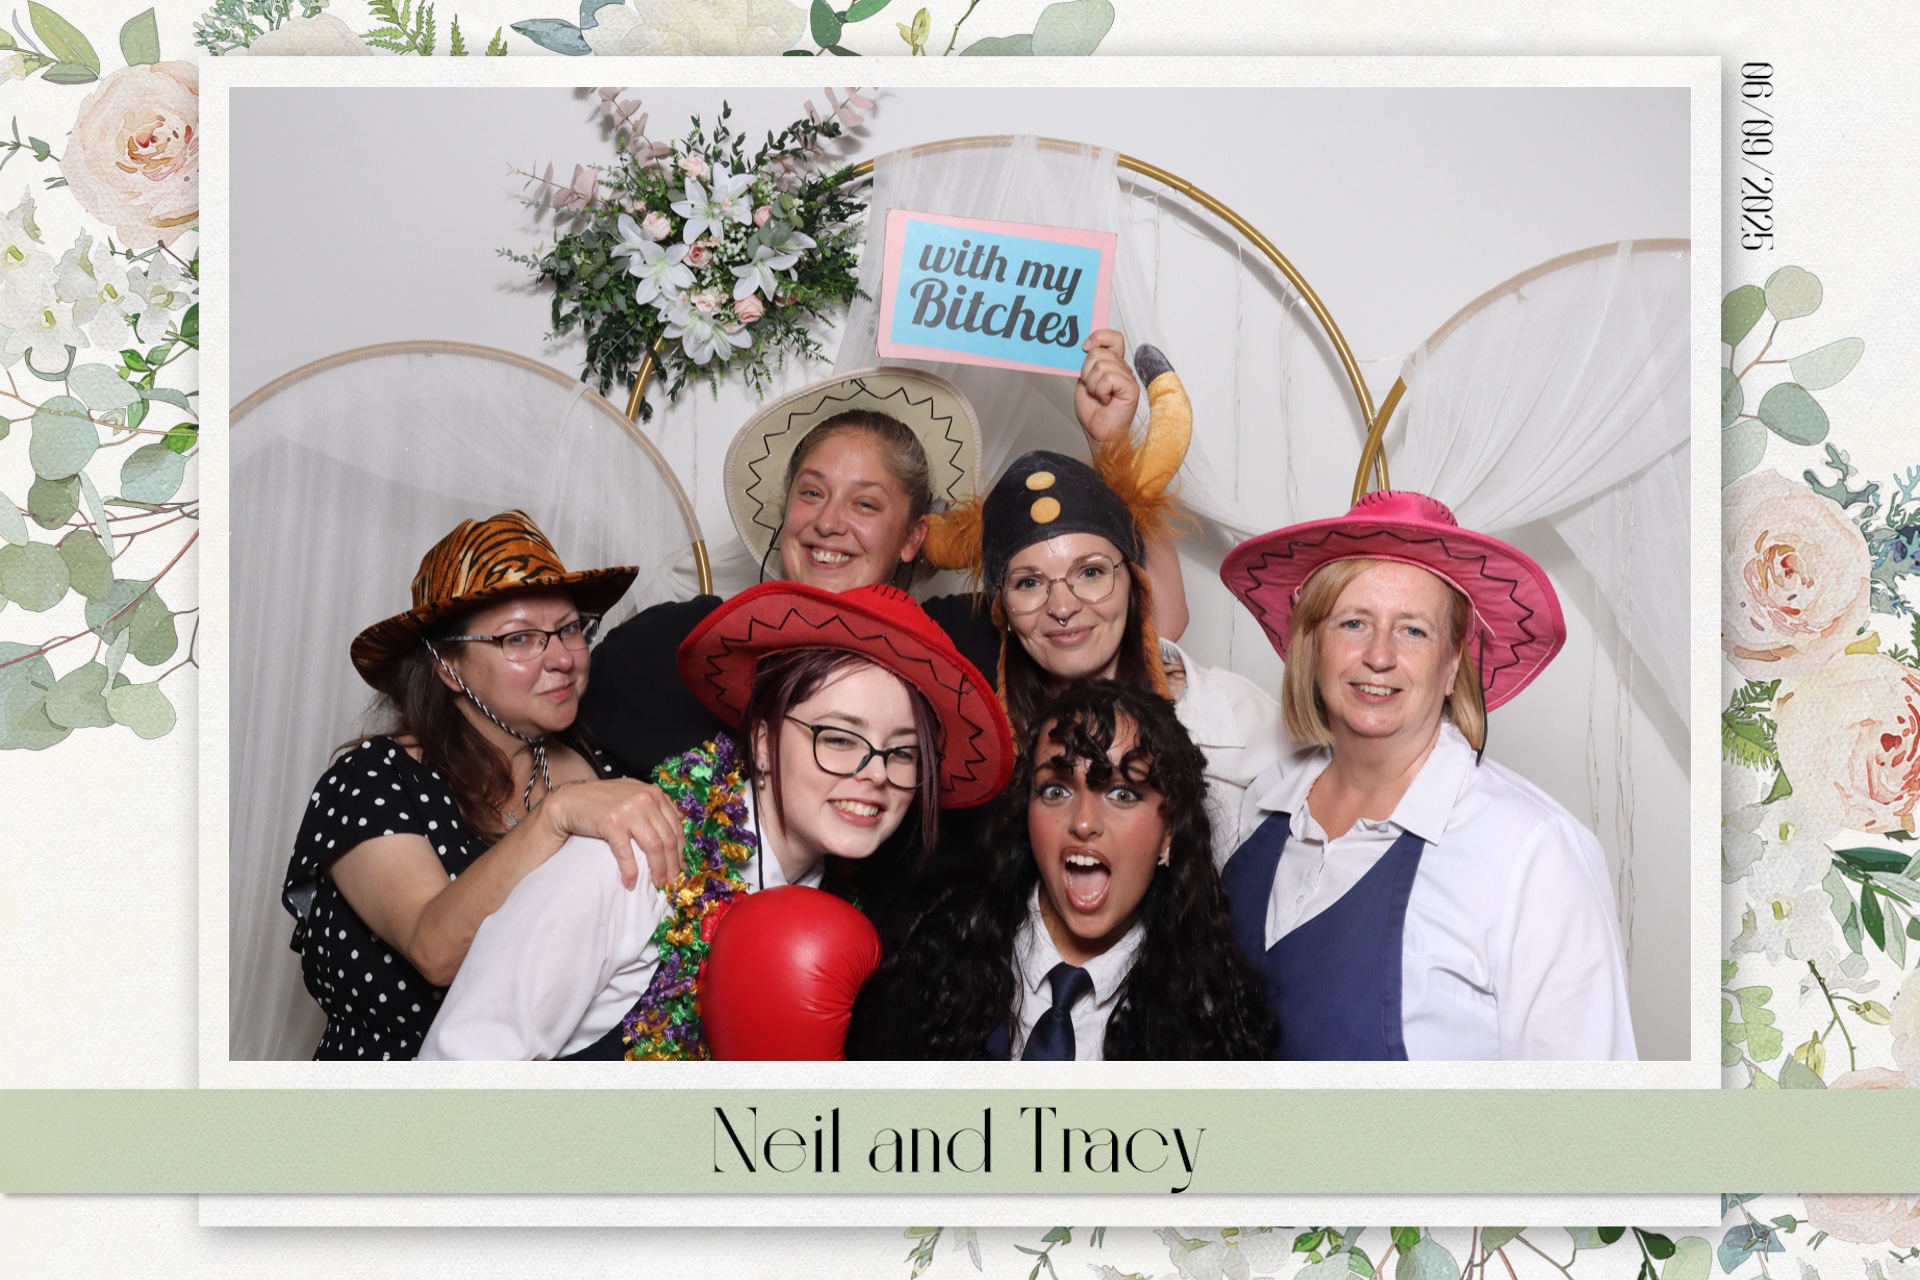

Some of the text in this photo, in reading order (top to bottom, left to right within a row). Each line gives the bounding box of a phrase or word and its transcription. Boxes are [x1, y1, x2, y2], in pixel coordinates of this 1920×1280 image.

[918, 239, 1083, 306] with my
[910, 277, 1080, 348] Bitches
